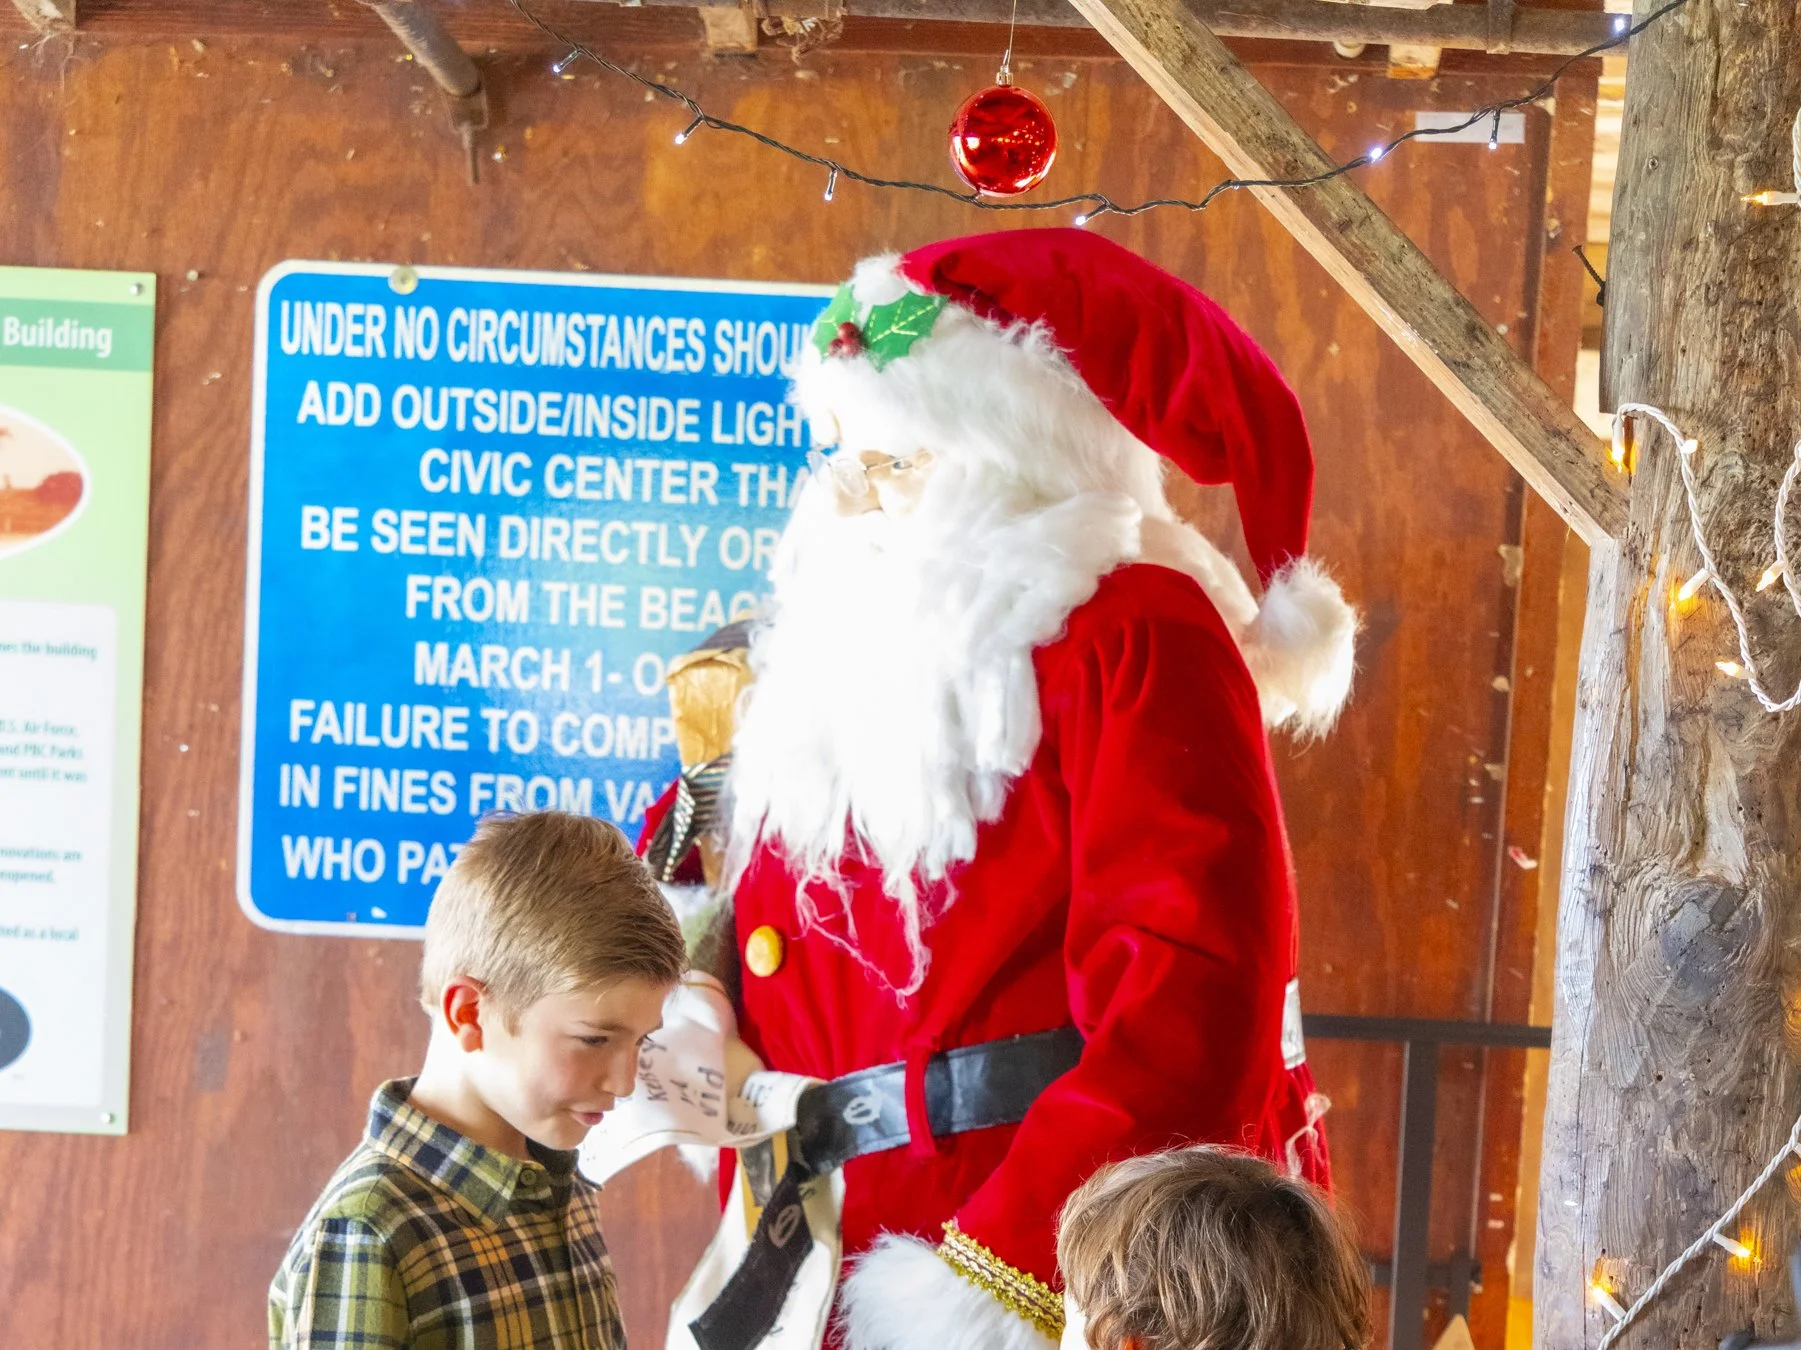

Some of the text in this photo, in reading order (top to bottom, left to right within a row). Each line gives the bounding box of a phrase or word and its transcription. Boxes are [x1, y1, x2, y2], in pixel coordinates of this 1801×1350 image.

[3, 317, 113, 358] Building
[280, 300, 809, 377] UNDER NO CIRCUMSTANCES SHOU
[297, 380, 802, 448] ADD OUTSIDE/INSIDE LIGH
[419, 448, 810, 509] CIVIC CENTER THA
[301, 505, 360, 551] BE
[371, 509, 486, 557] SEEN
[499, 514, 710, 570] DIRECTLY
[405, 573, 529, 626] FROM
[542, 581, 625, 629] THE
[414, 640, 571, 692] MARCH
[288, 697, 678, 761] FAILURE TO COMP
[279, 762, 671, 824] IN FINES FROM VA
[281, 834, 386, 884] WHO
